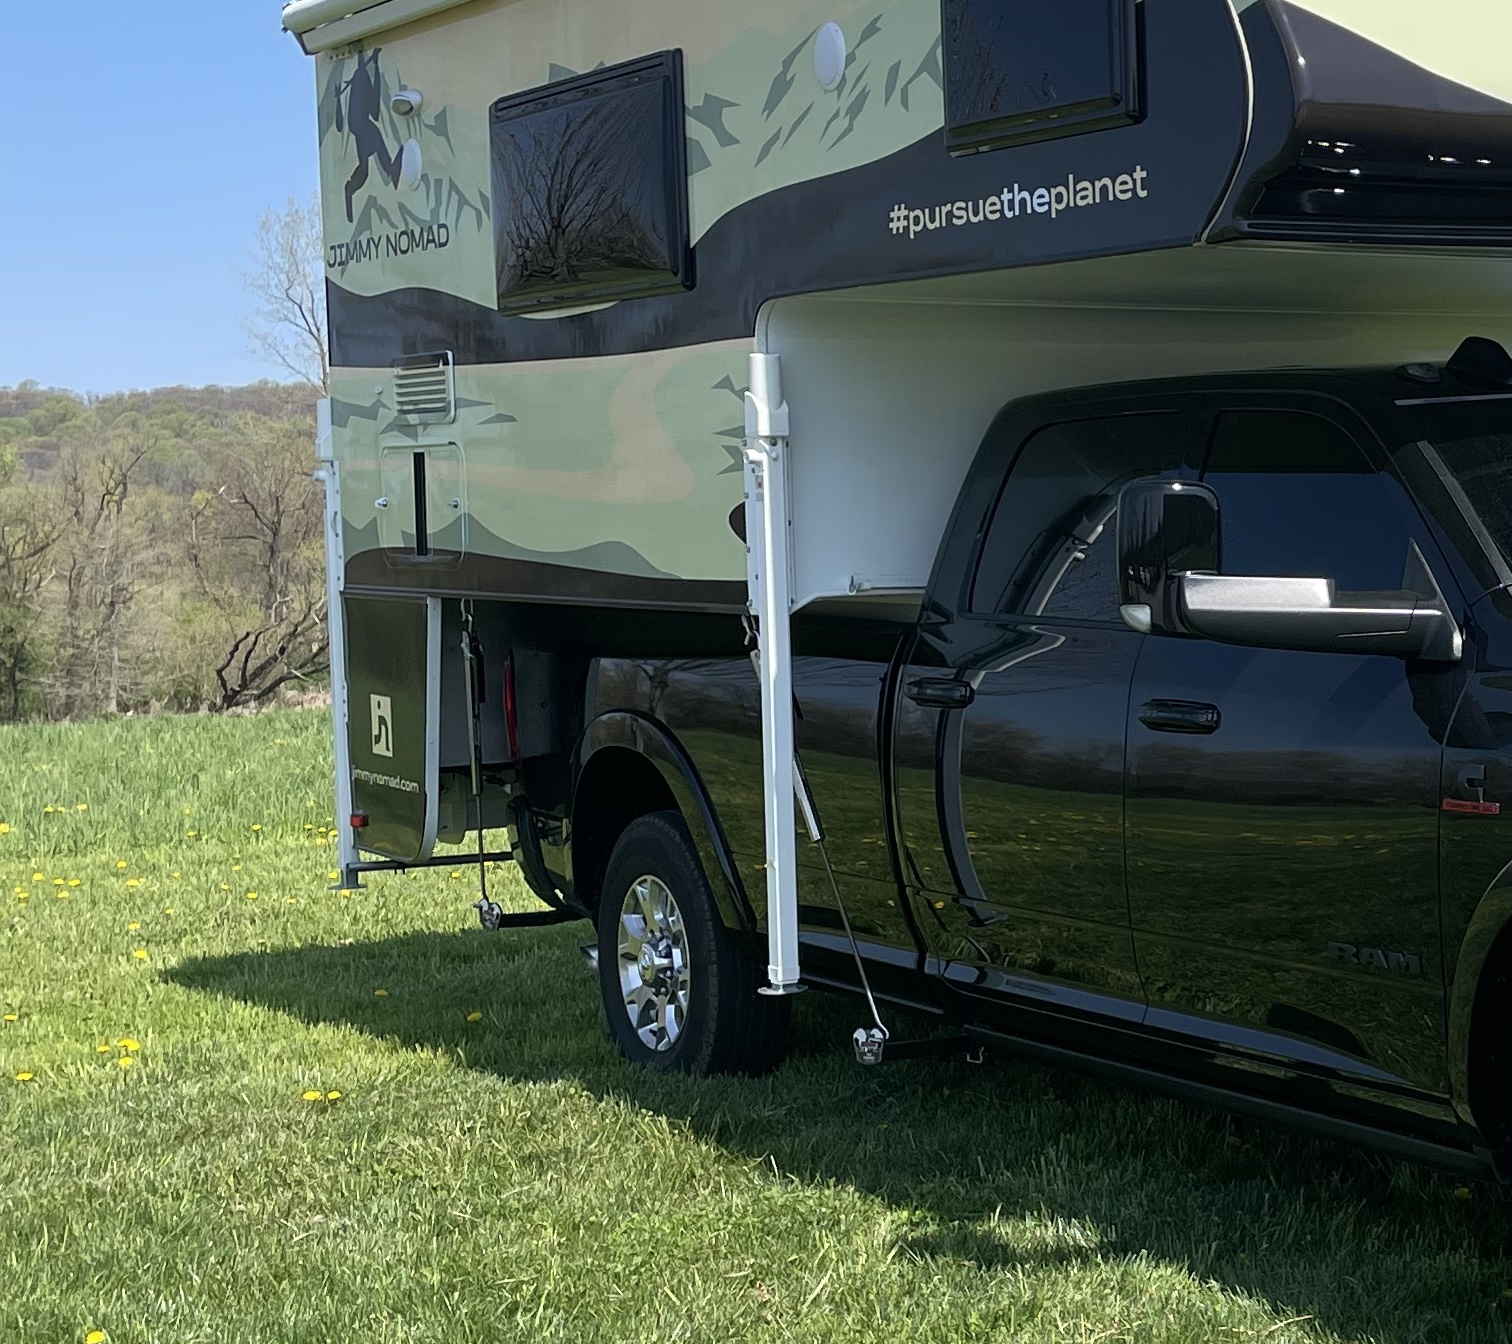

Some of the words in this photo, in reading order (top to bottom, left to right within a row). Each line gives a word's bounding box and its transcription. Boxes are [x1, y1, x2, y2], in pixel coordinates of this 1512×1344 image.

[888, 164, 1148, 239] #pursuetheplanet
[327, 234, 382, 269] JIMMY
[386, 223, 450, 258] NOMAD
[1327, 940, 1422, 974] RAM
